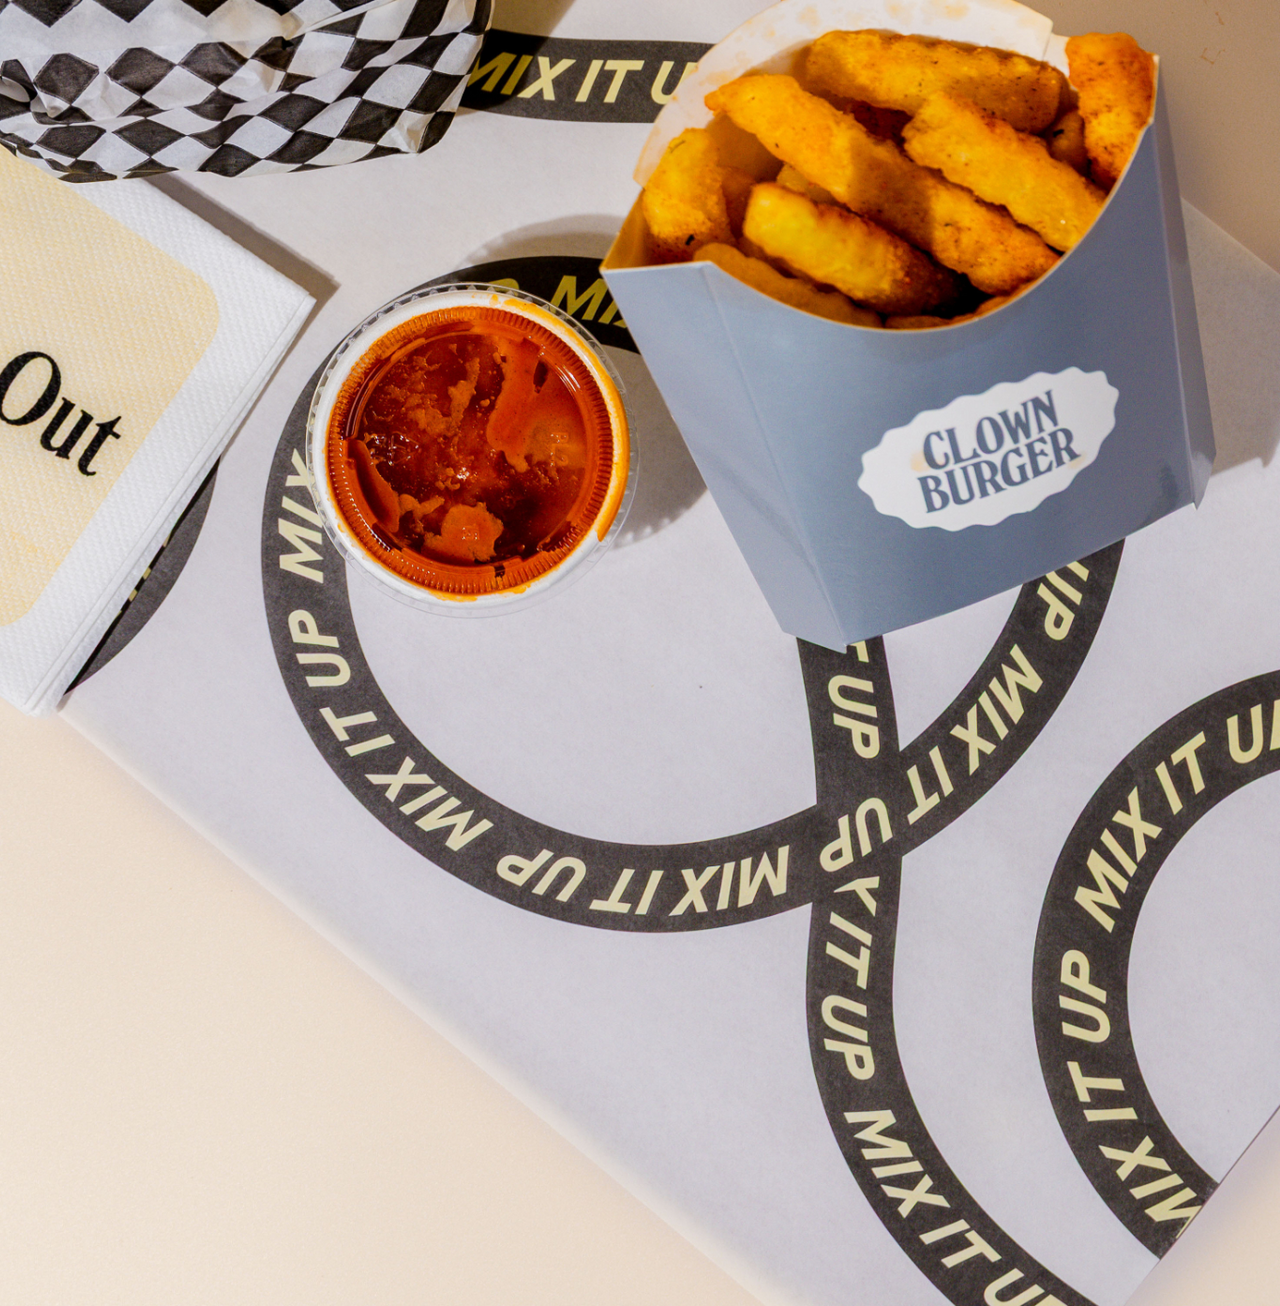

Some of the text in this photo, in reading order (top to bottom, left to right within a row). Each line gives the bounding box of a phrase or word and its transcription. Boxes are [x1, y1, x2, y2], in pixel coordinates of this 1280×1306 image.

[574, 59, 646, 104] IT
[650, 60, 701, 106] U
[550, 274, 628, 329] MI
[922, 389, 1060, 470] CLOWN
[916, 427, 1081, 514] BURGER
[287, 609, 352, 688] UP
[318, 706, 396, 757] IT
[827, 674, 881, 759] UP
[950, 643, 1044, 776] MIX
[365, 756, 494, 852] MIX
[906, 744, 955, 826] IT
[1154, 730, 1207, 816] IT
[818, 797, 894, 872] UP
[1073, 785, 1163, 934] MIX
[496, 848, 587, 903] UP
[589, 868, 664, 916] IT
[668, 844, 790, 917] MIX
[825, 911, 873, 990] IT
[1058, 948, 1112, 1044] UP
[821, 994, 876, 1081] UP
[1066, 1060, 1139, 1122] IT
[843, 1108, 951, 1219] MIX
[1098, 1134, 1205, 1239] MIX
[918, 1218, 1002, 1270] IT
[983, 1267, 1069, 1306] U
